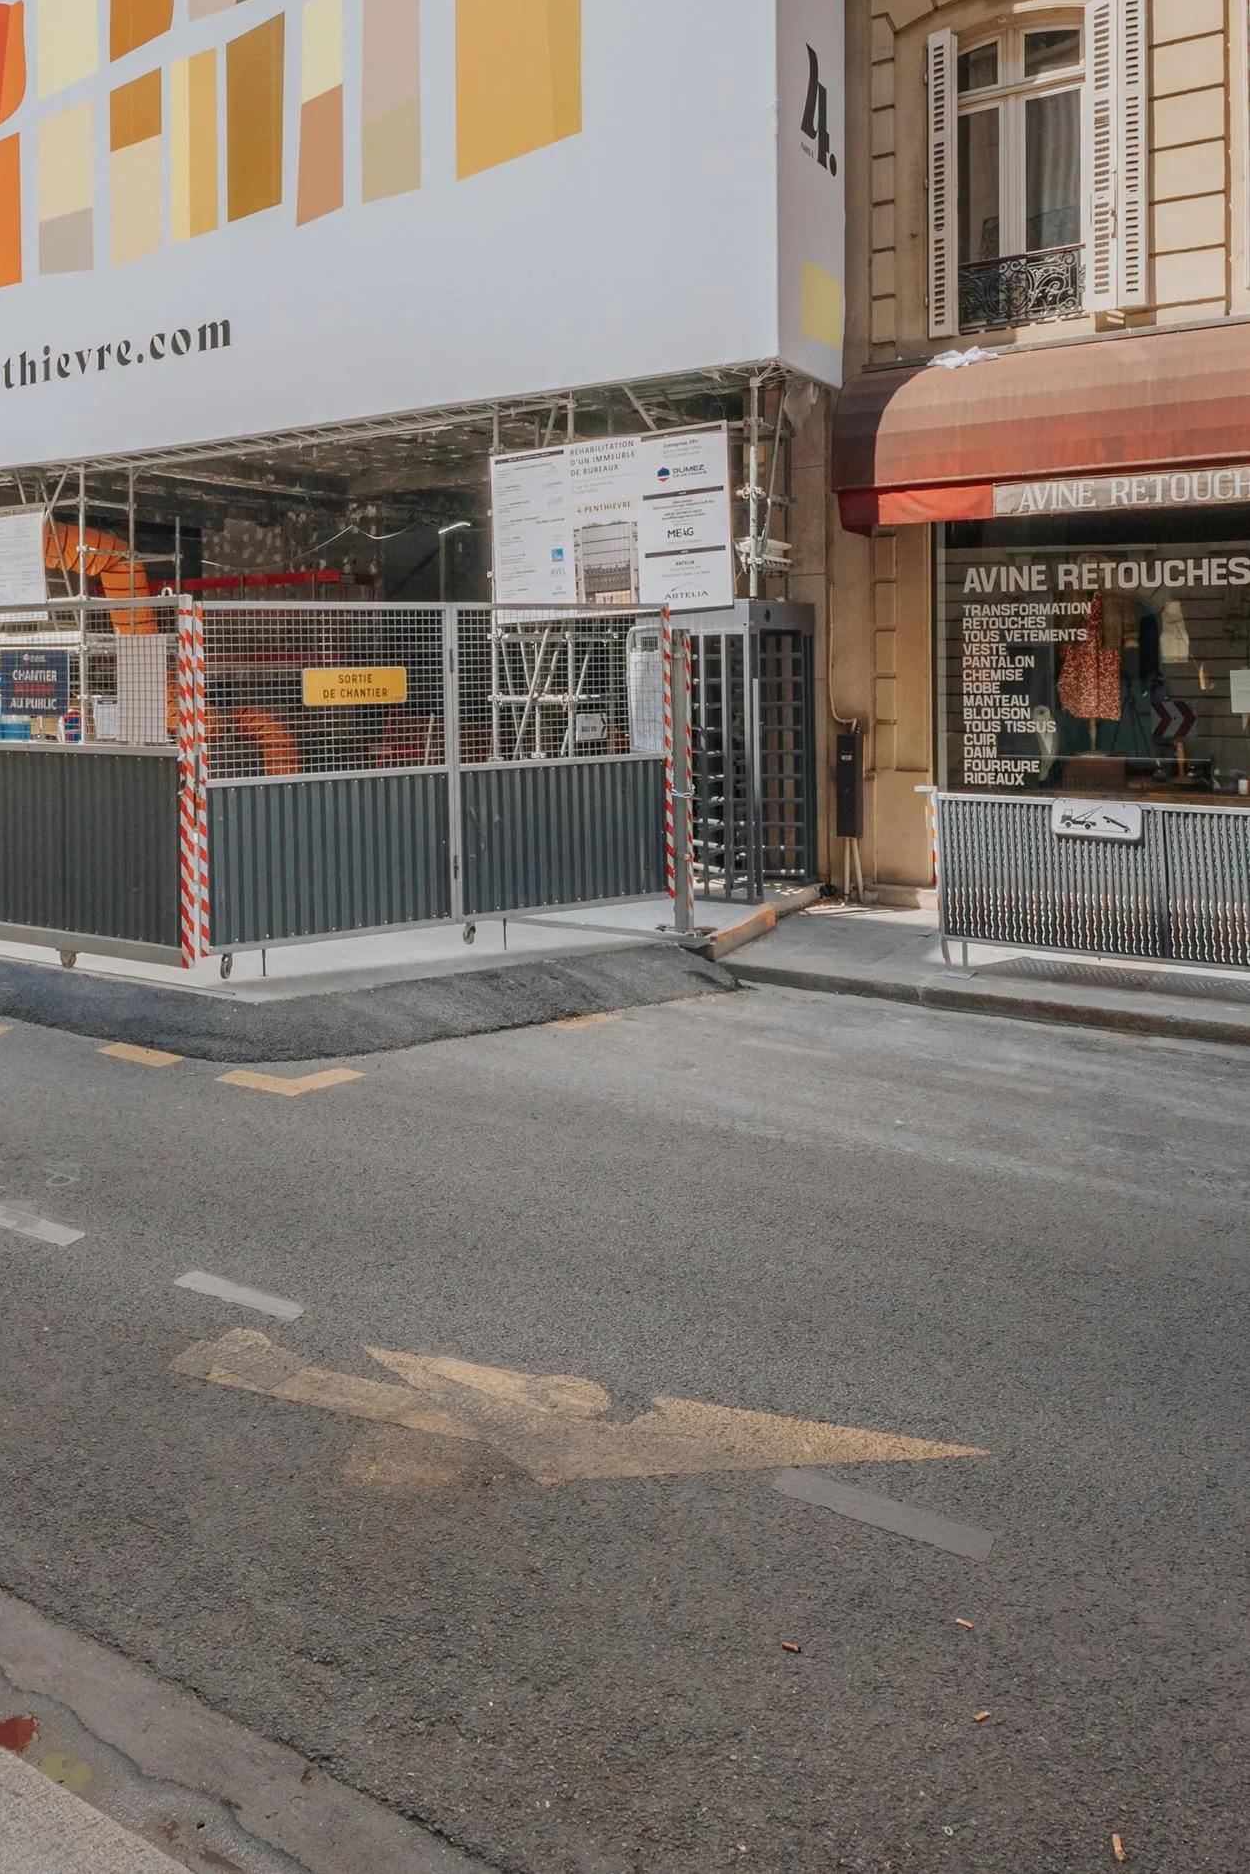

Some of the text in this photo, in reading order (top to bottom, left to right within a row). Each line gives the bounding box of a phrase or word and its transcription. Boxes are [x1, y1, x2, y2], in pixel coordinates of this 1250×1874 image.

[569, 440, 634, 456] RÉHABILITATION
[570, 450, 635, 467] D'UN IMMEUBLE
[570, 463, 619, 476] DE BUREAUX
[672, 464, 704, 474] DUMEZ
[1019, 480, 1096, 512] AVINE
[584, 500, 631, 513] PENTHIEVRE
[667, 527, 694, 538] MEAG
[963, 557, 1250, 593] AVINE RETOUCHES
[664, 590, 709, 600] ARTELIA
[963, 602, 1091, 616] TRANSFORMATION
[963, 616, 1046, 629] RETOUCHES
[963, 628, 1087, 642] TOUS VETEMENTS
[963, 643, 1007, 655] VESTE
[963, 655, 1035, 668] PANTALON
[12, 670, 57, 682] CHANTIER
[338, 674, 373, 684] SORTIE
[963, 669, 1023, 681] CHEMISE
[323, 689, 335, 698] DE
[340, 688, 388, 698] CHANTIER
[963, 682, 1000, 694] ROBE
[25, 698, 57, 710] PUBLIC
[963, 694, 1029, 707] MANTEAU
[963, 707, 1031, 719] BLOUSON
[963, 720, 1057, 733] TOUS TISSUS
[964, 733, 996, 745] CUIR
[964, 746, 997, 758] DAIM
[964, 760, 1040, 772] FOURRURE
[964, 773, 1025, 786] RIDEAUX
